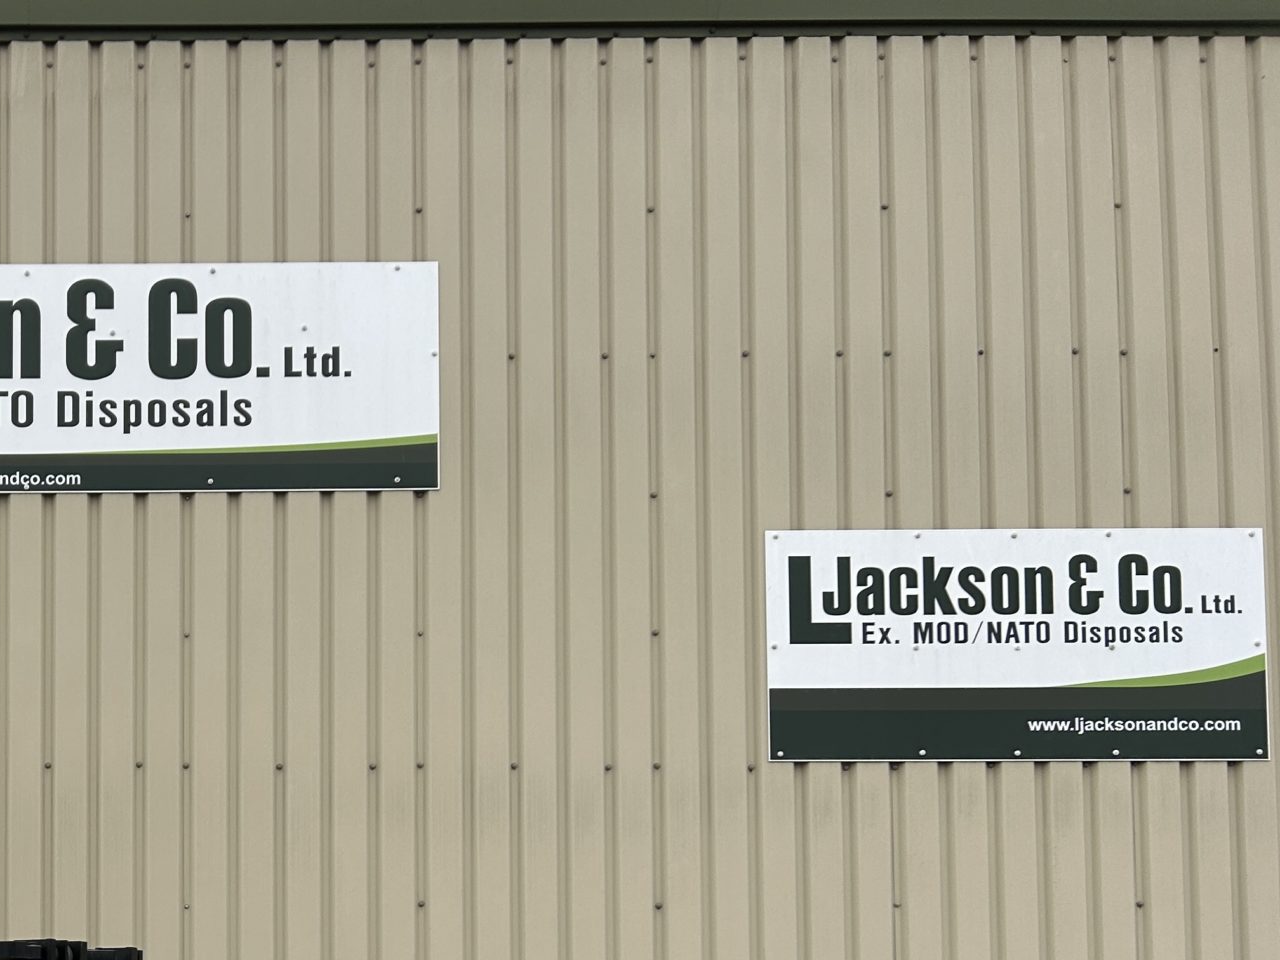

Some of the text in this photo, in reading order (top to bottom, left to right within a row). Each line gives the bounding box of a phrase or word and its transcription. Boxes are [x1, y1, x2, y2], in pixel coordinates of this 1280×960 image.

[65, 278, 124, 381] &
[148, 278, 270, 380] Co.
[284, 346, 352, 378] Ltd.
[57, 390, 252, 435] Disposals
[1068, 554, 1104, 616] &
[1118, 553, 1193, 615] Co.
[1201, 595, 1243, 614] Ltd.
[862, 620, 1183, 648] Ex. MOD/NATO Disposals
[1027, 717, 1241, 735] www.ljacksonandco.com
